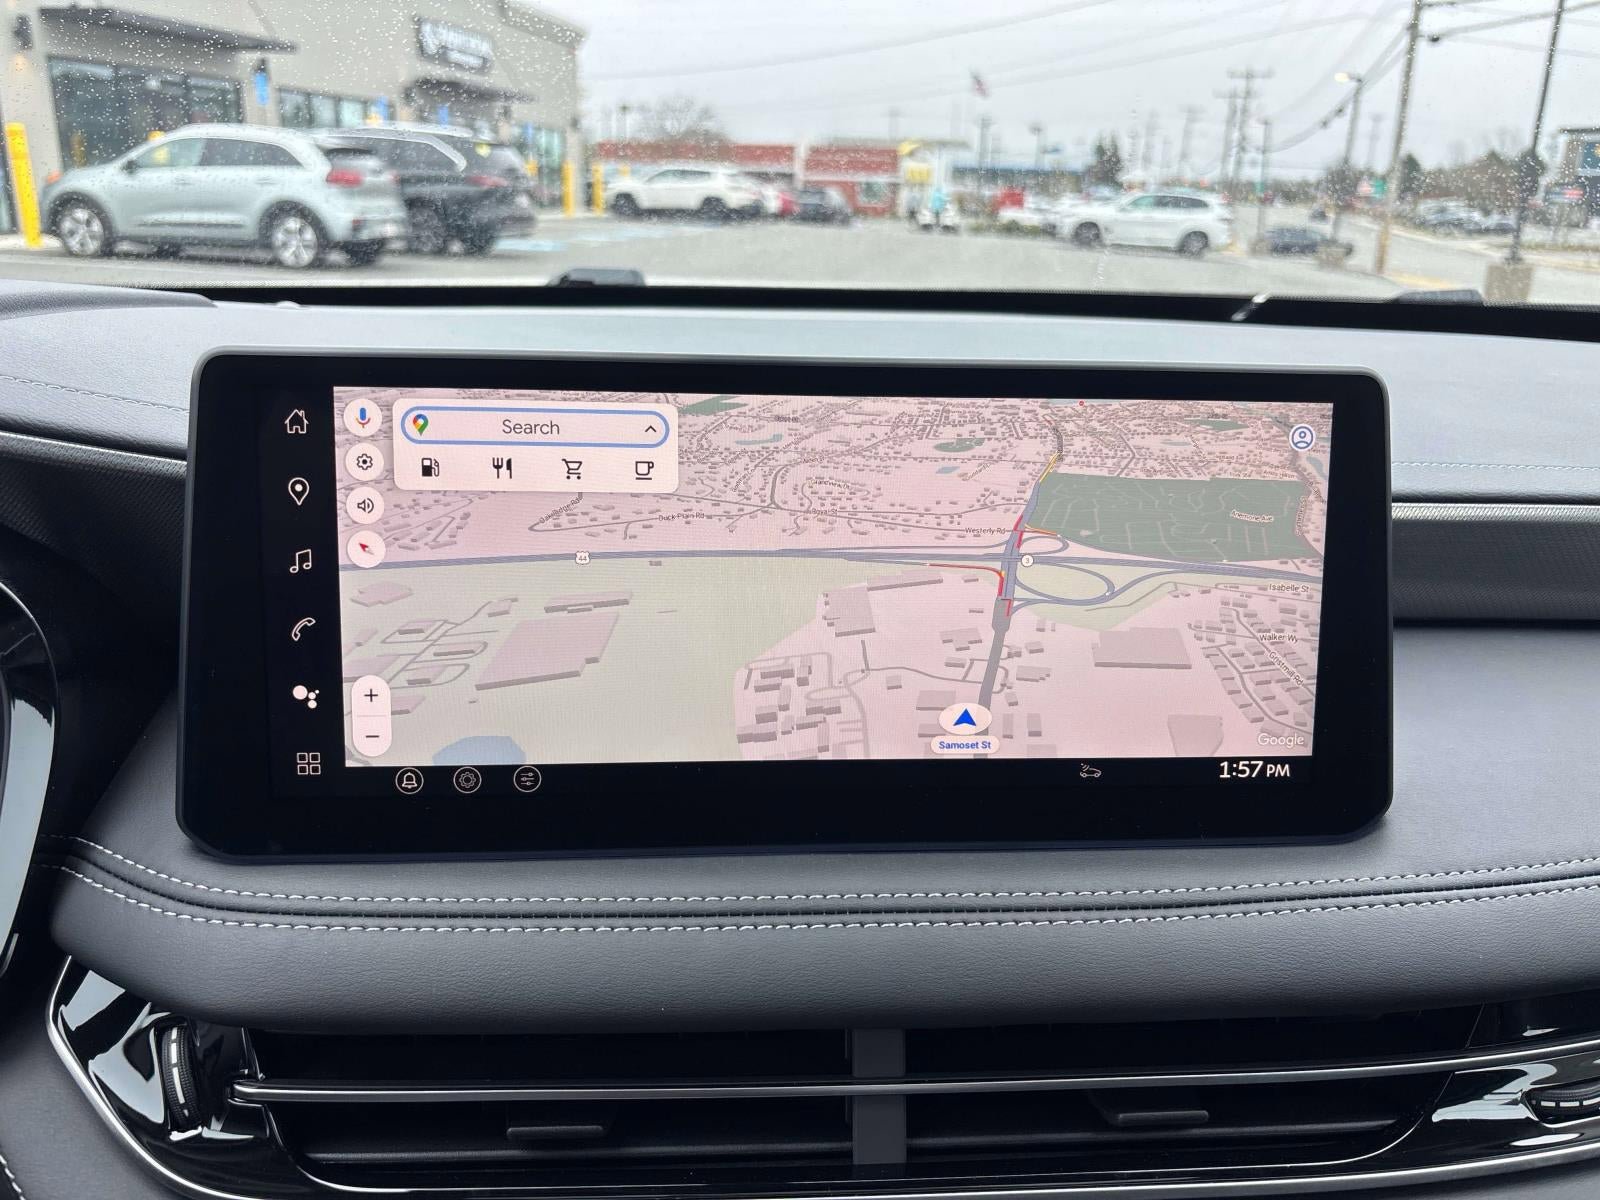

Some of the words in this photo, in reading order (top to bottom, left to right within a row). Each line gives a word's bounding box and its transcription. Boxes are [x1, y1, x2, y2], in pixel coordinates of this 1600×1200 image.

[502, 419, 560, 435] Search
[570, 496, 581, 505] Rd
[677, 512, 695, 520] Plain
[695, 511, 705, 519] Rd
[964, 527, 995, 535] Westerly
[1269, 583, 1300, 592] Isabelle
[1301, 585, 1309, 593] St
[1259, 633, 1285, 641] Walker
[1269, 651, 1296, 679] Gristmill
[1293, 674, 1304, 686] Rd
[938, 740, 979, 750] Samoset
[981, 740, 991, 750] St
[1257, 732, 1304, 749] Google
[1219, 760, 1264, 778] 1:57
[1266, 763, 1290, 777] PM
